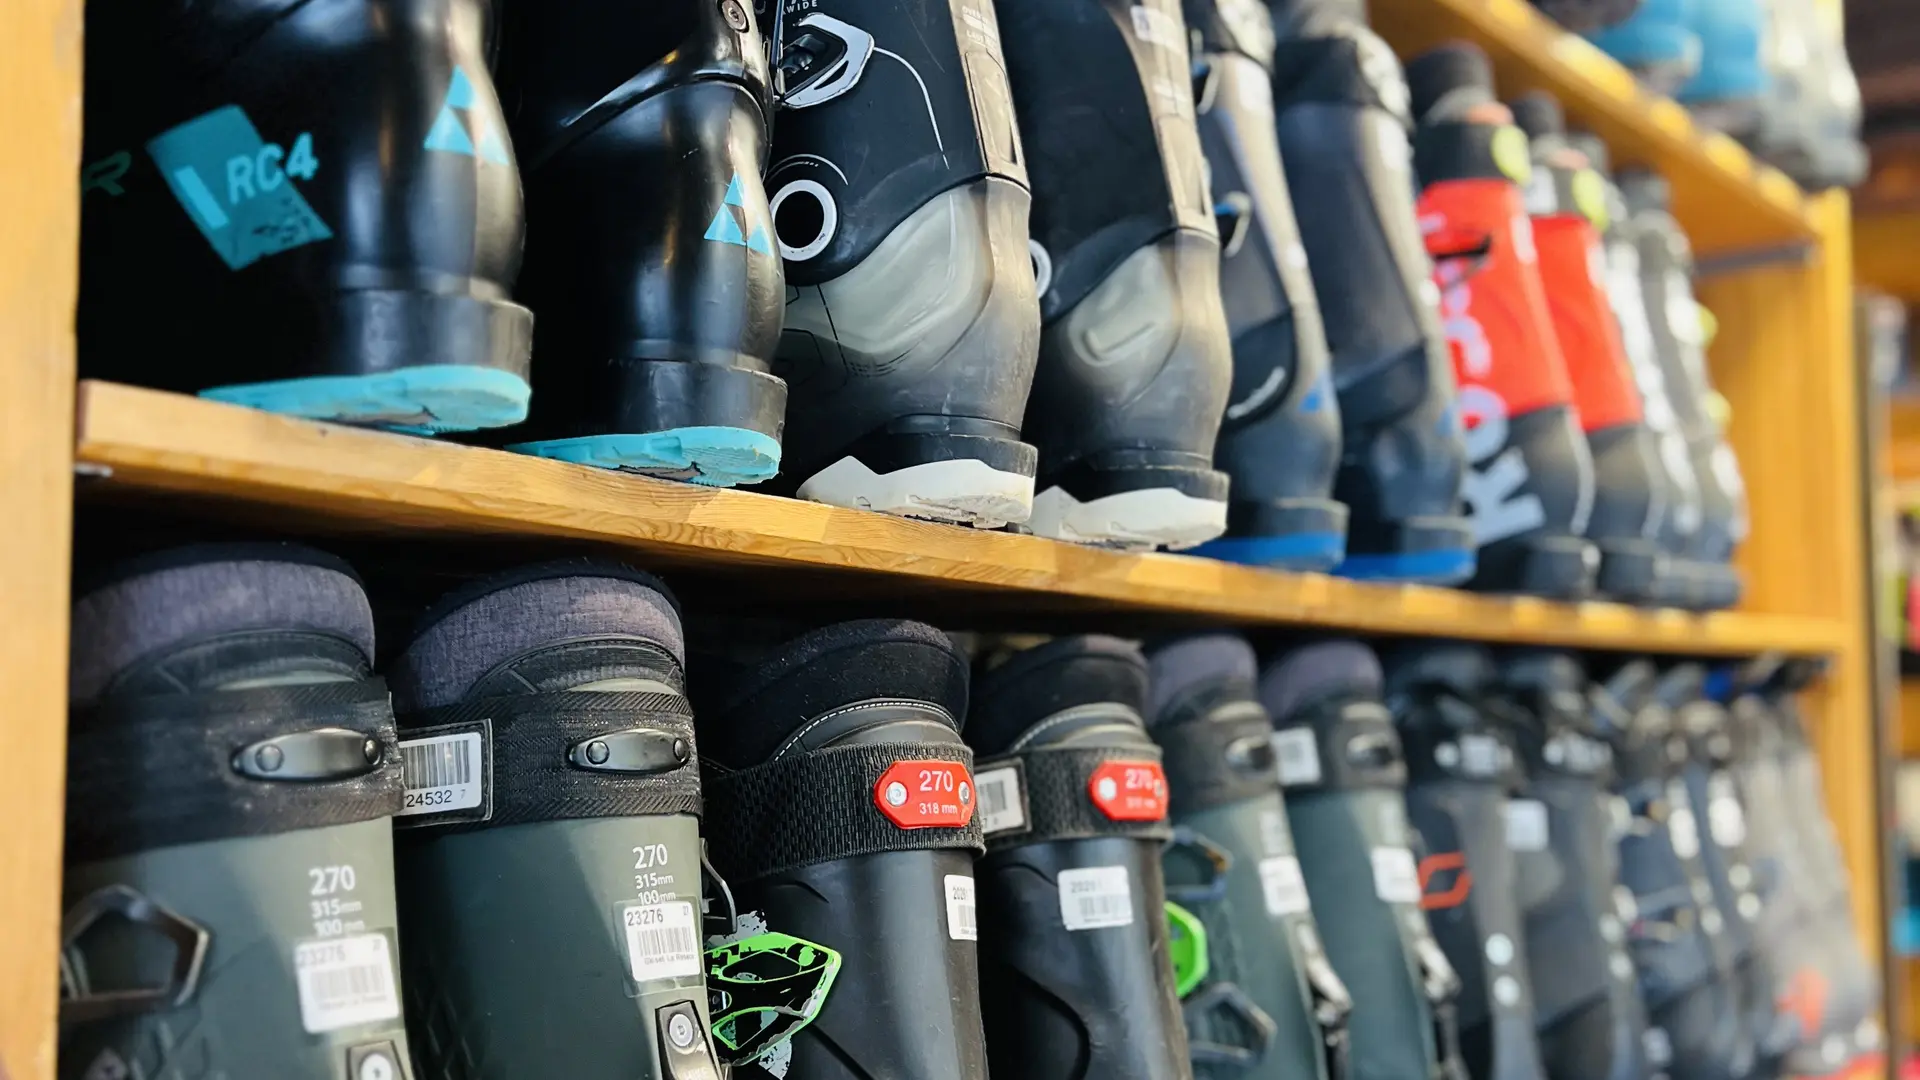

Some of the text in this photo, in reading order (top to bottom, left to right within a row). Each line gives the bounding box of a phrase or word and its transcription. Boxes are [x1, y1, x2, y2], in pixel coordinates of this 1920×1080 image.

[227, 132, 319, 205] RC4
[919, 770, 953, 792] 270
[406, 789, 453, 807] 24532
[919, 802, 958, 815] 318 mm
[632, 843, 668, 869] 270
[308, 865, 356, 895] 270
[635, 872, 674, 889] 315mm
[626, 908, 664, 927] 23276
